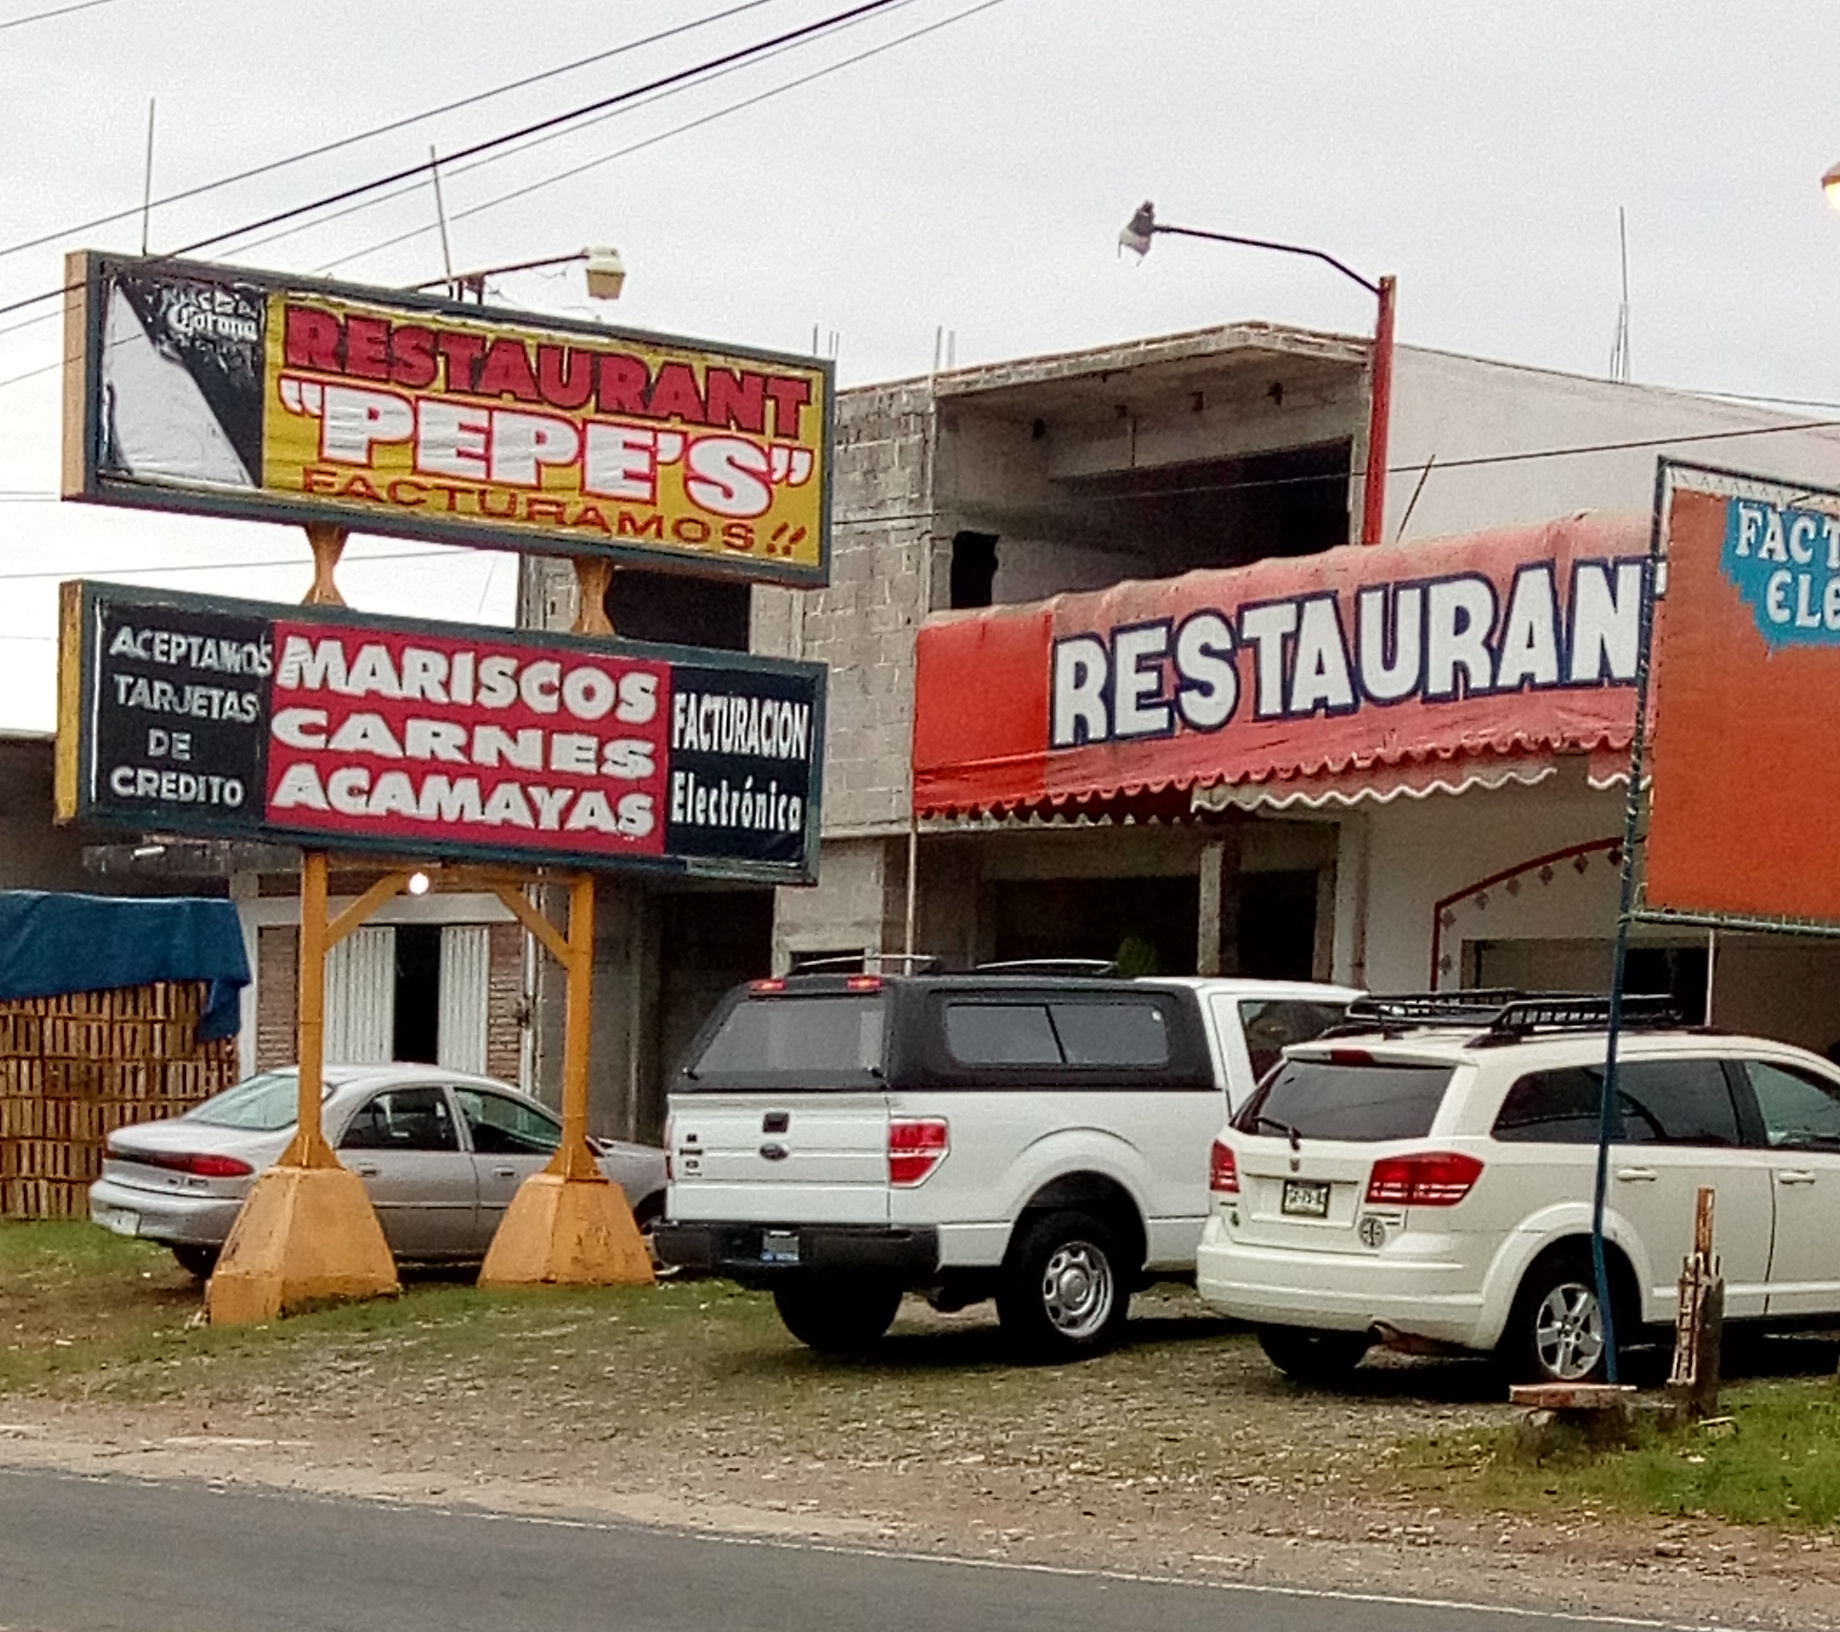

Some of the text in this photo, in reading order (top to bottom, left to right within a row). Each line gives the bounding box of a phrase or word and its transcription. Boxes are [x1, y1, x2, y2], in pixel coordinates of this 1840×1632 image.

[167, 303, 258, 341] Corona
[285, 304, 812, 440] RESTAURANT
[109, 625, 272, 677] ACEPTAMOS
[276, 634, 659, 725] MARISCOS
[1048, 557, 1667, 749] RESTAURAN
[113, 673, 259, 723] TARJETAS
[672, 691, 810, 760] FACTURACION
[147, 727, 192, 761] DE
[271, 706, 656, 780] CARNES
[110, 765, 245, 808] CREDITO
[270, 762, 655, 837] ACAMAYAS
[671, 770, 802, 831] Electrónica
